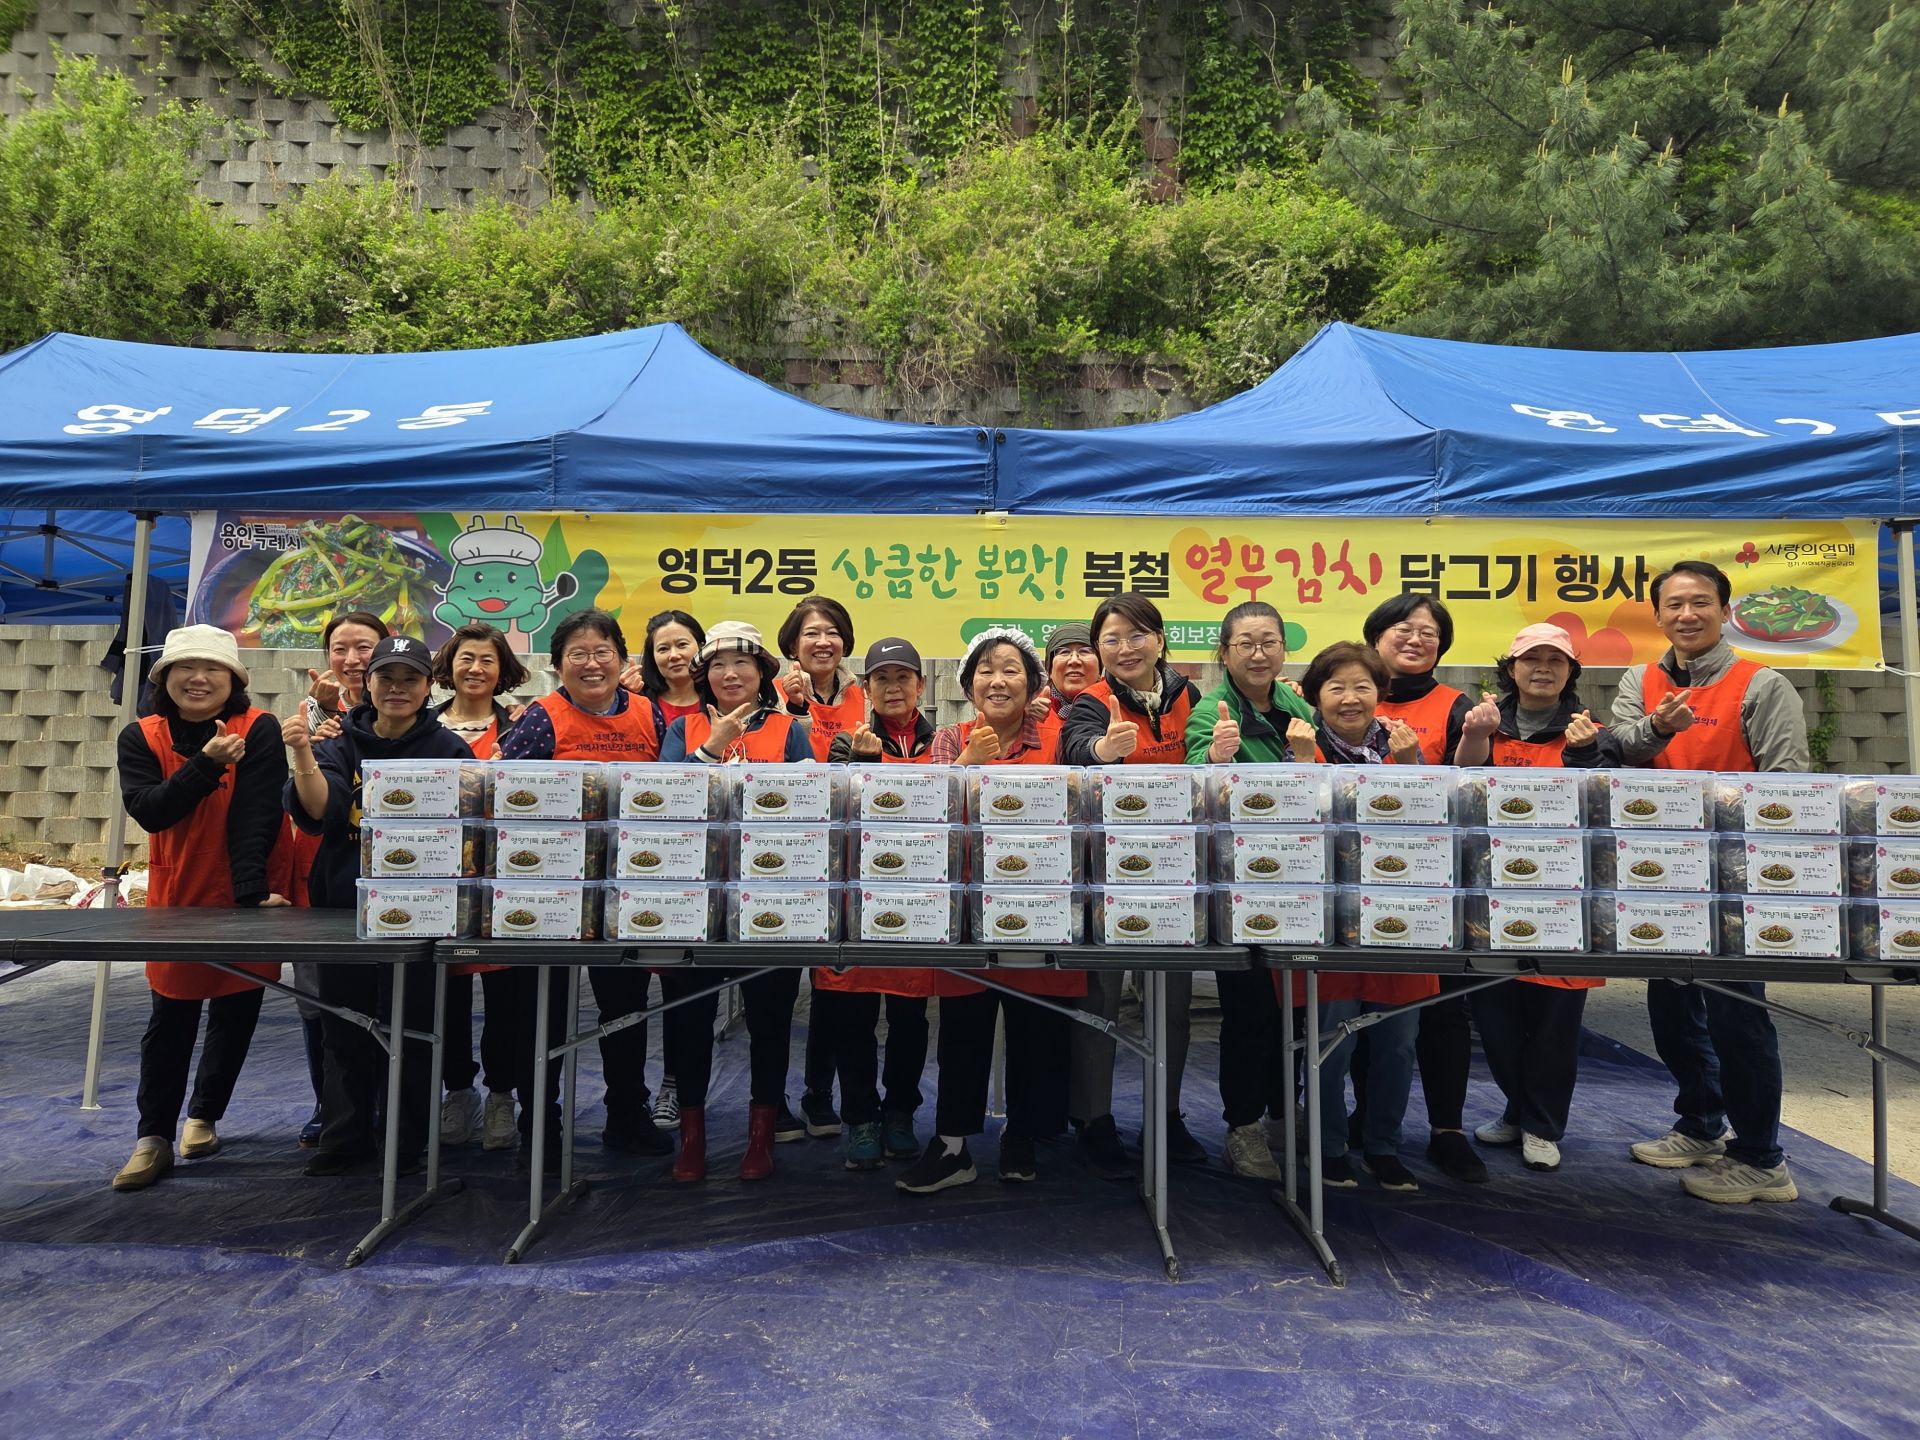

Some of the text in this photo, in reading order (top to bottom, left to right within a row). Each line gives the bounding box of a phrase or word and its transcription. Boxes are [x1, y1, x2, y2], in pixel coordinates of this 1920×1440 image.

[220, 522, 301, 550] 용인특례시
[1765, 543, 1855, 561] 사랑의열매
[657, 538, 1650, 604] 영덕2동 상큼한 봄맛! 봄철 열무김치 담그기 행사
